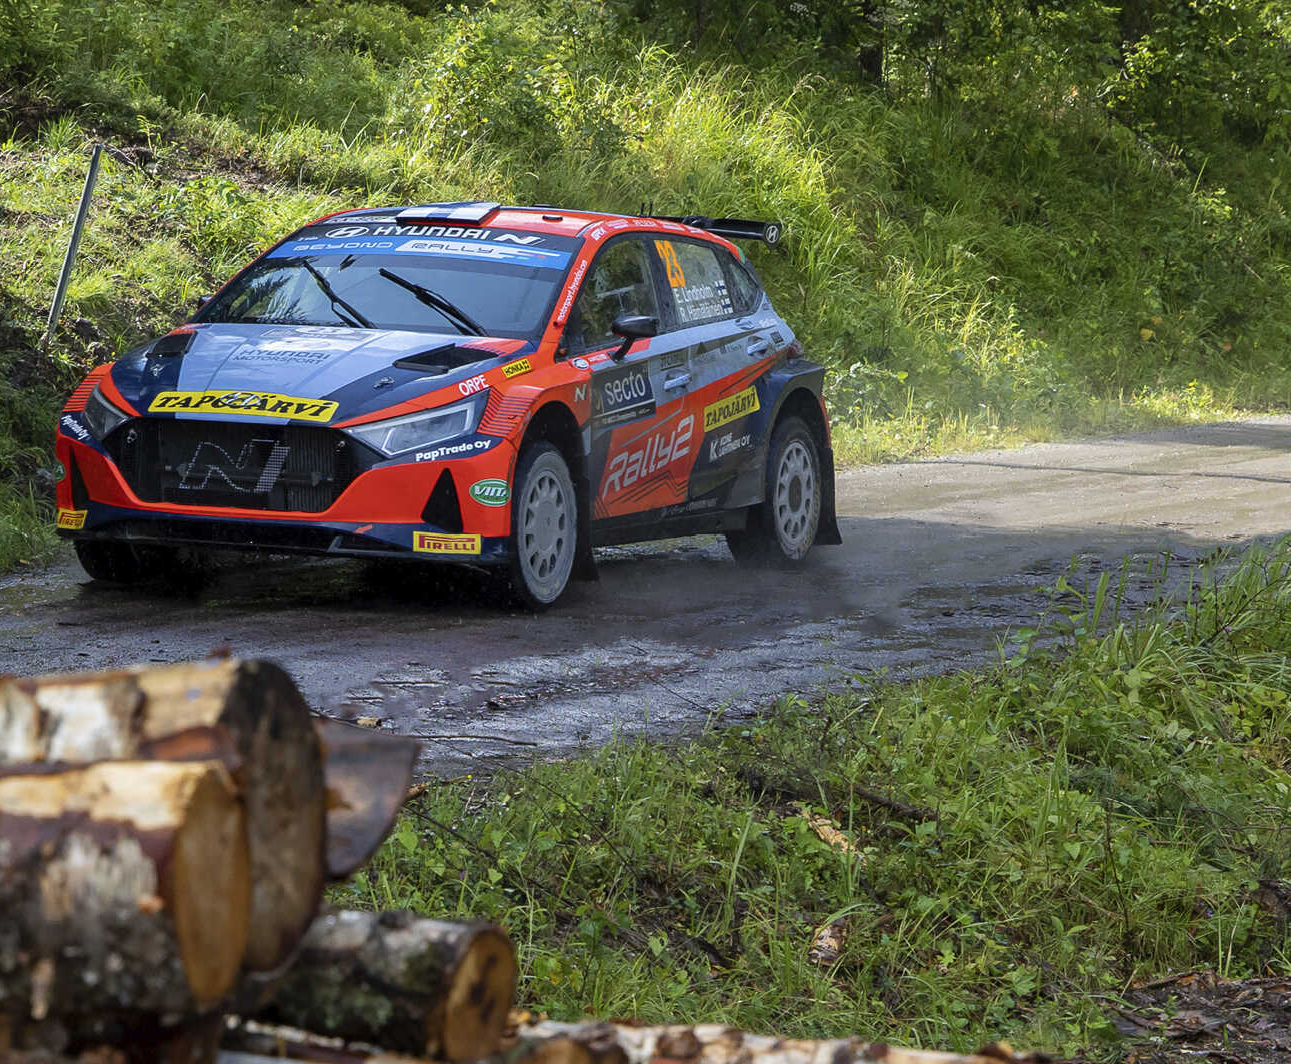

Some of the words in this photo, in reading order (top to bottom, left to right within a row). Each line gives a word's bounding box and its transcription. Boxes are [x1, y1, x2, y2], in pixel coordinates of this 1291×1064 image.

[372, 226, 491, 240] HYUNDAI
[293, 241, 394, 252] BEYOND
[410, 243, 495, 254] RALLY
[654, 240, 686, 288] 23
[681, 283, 714, 303] Lindholm
[232, 354, 325, 365] MOTORSPORT
[239, 349, 332, 360] HYUNDAI
[458, 374, 490, 397] ORPE
[604, 371, 646, 405] secto
[415, 443, 474, 462] PapTrade
[474, 439, 492, 450] Oy
[602, 414, 695, 501] Rally2
[418, 535, 476, 551] PIRELLI
